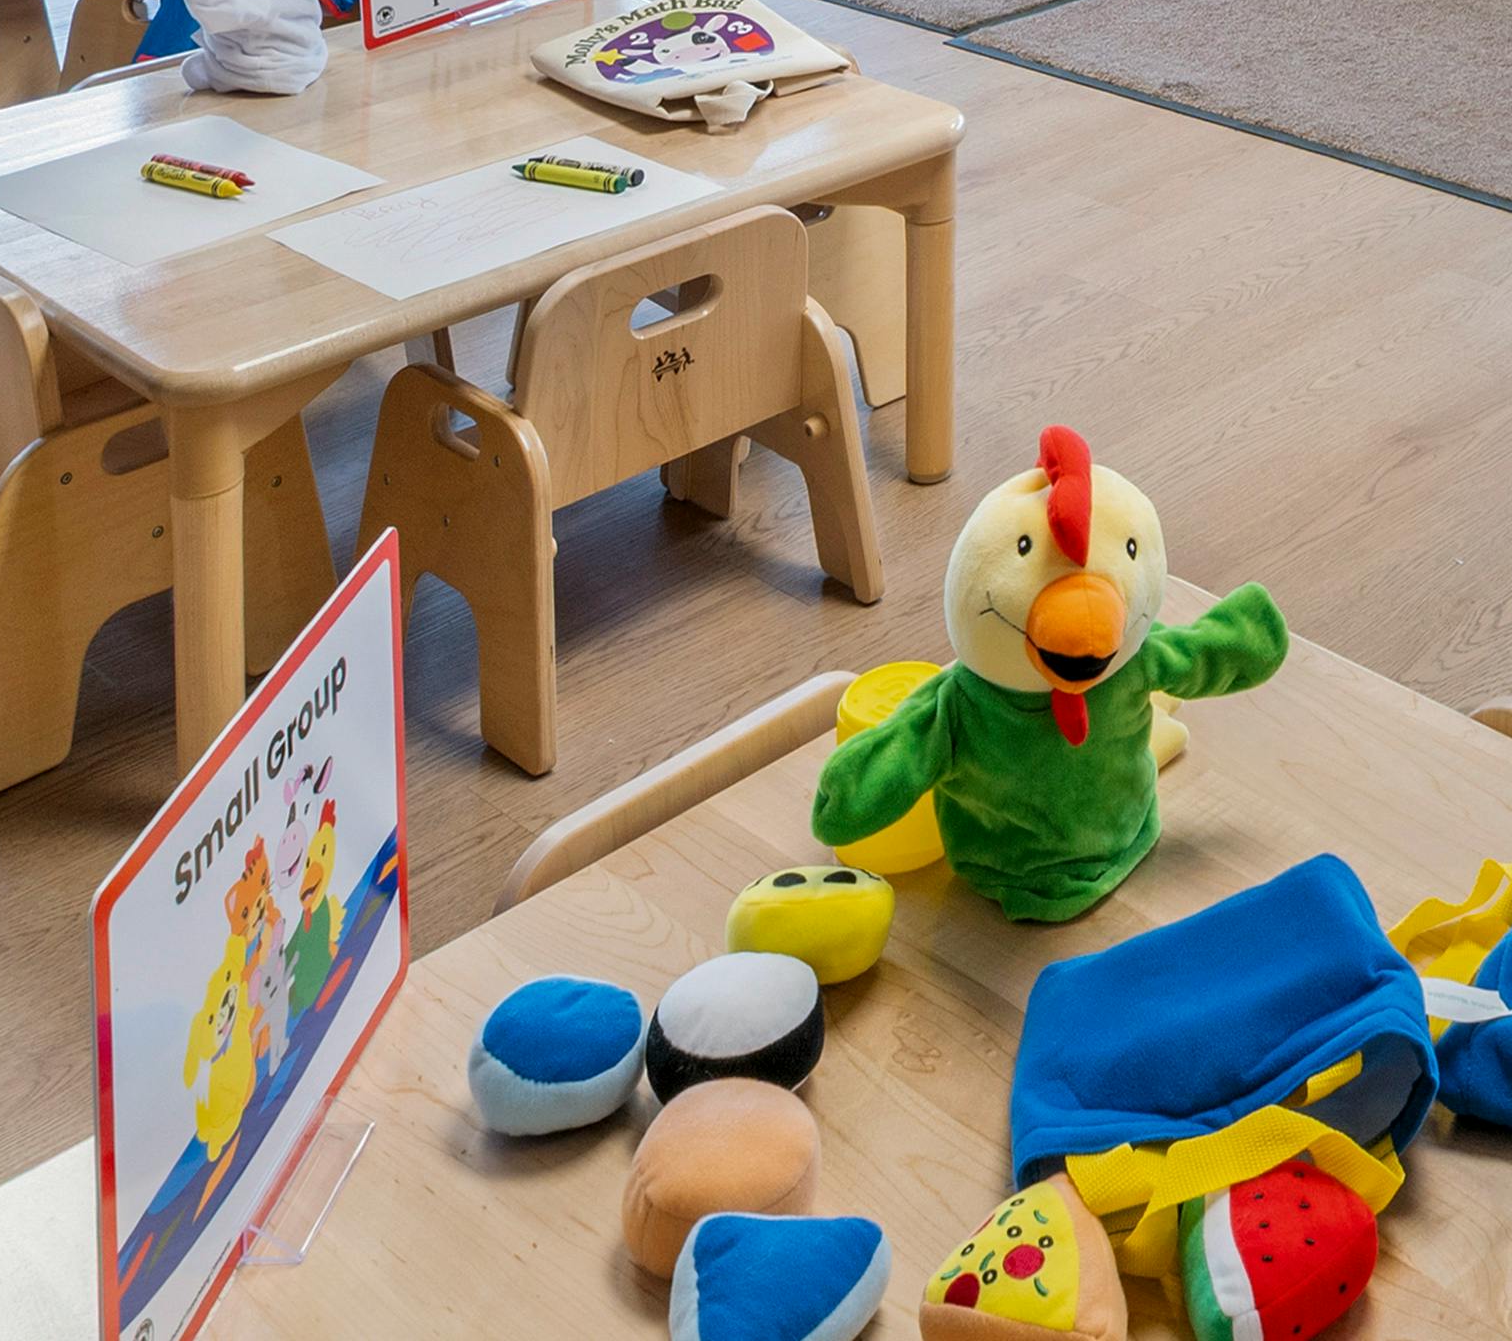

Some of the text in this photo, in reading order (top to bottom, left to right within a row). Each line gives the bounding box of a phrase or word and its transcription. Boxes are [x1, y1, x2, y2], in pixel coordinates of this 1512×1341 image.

[629, 31, 650, 45] 2
[727, 20, 754, 35] 3
[565, 24, 620, 69] Molly's
[175, 656, 347, 905] Small Group
